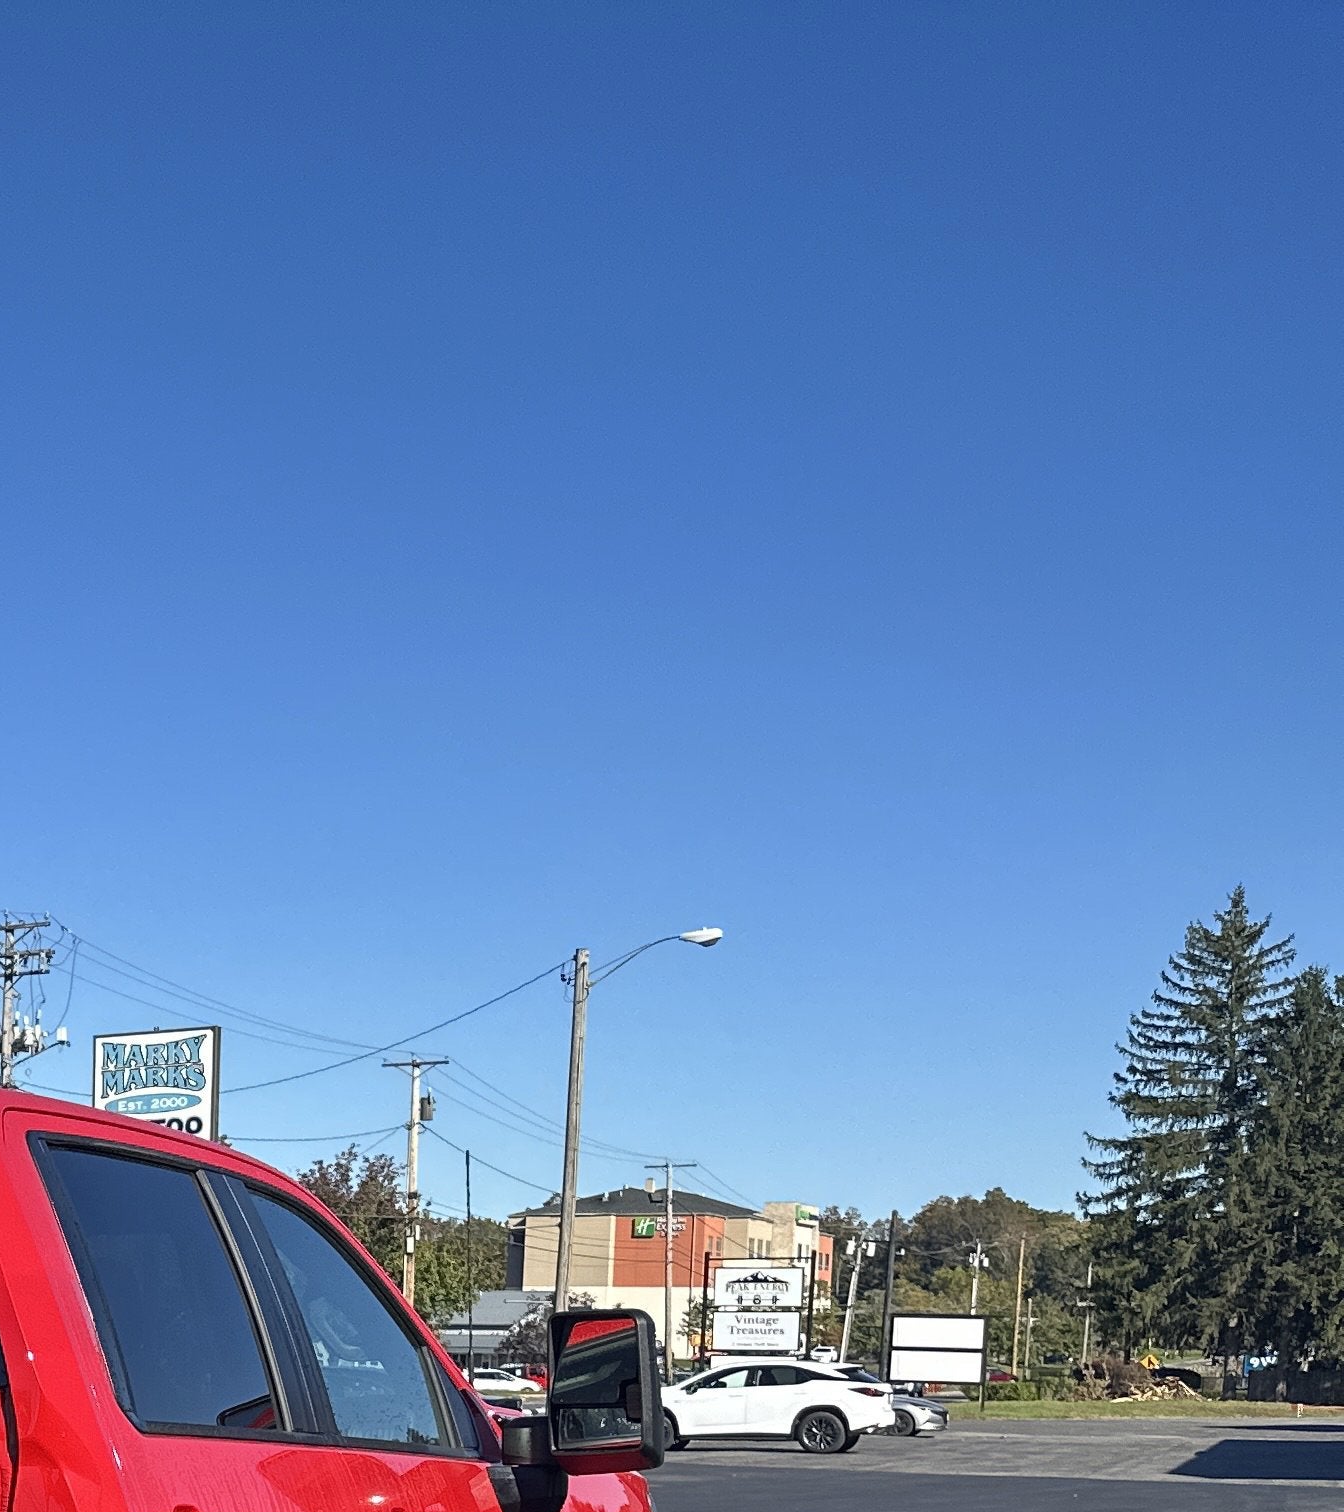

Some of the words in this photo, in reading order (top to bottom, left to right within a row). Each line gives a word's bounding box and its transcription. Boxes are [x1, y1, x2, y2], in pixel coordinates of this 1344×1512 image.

[102, 1034, 207, 1070] MARKY
[101, 1063, 206, 1098] MARKS
[150, 1096, 188, 1109] 2000
[735, 1315, 779, 1326] Vintage
[729, 1325, 785, 1335] Treasures
